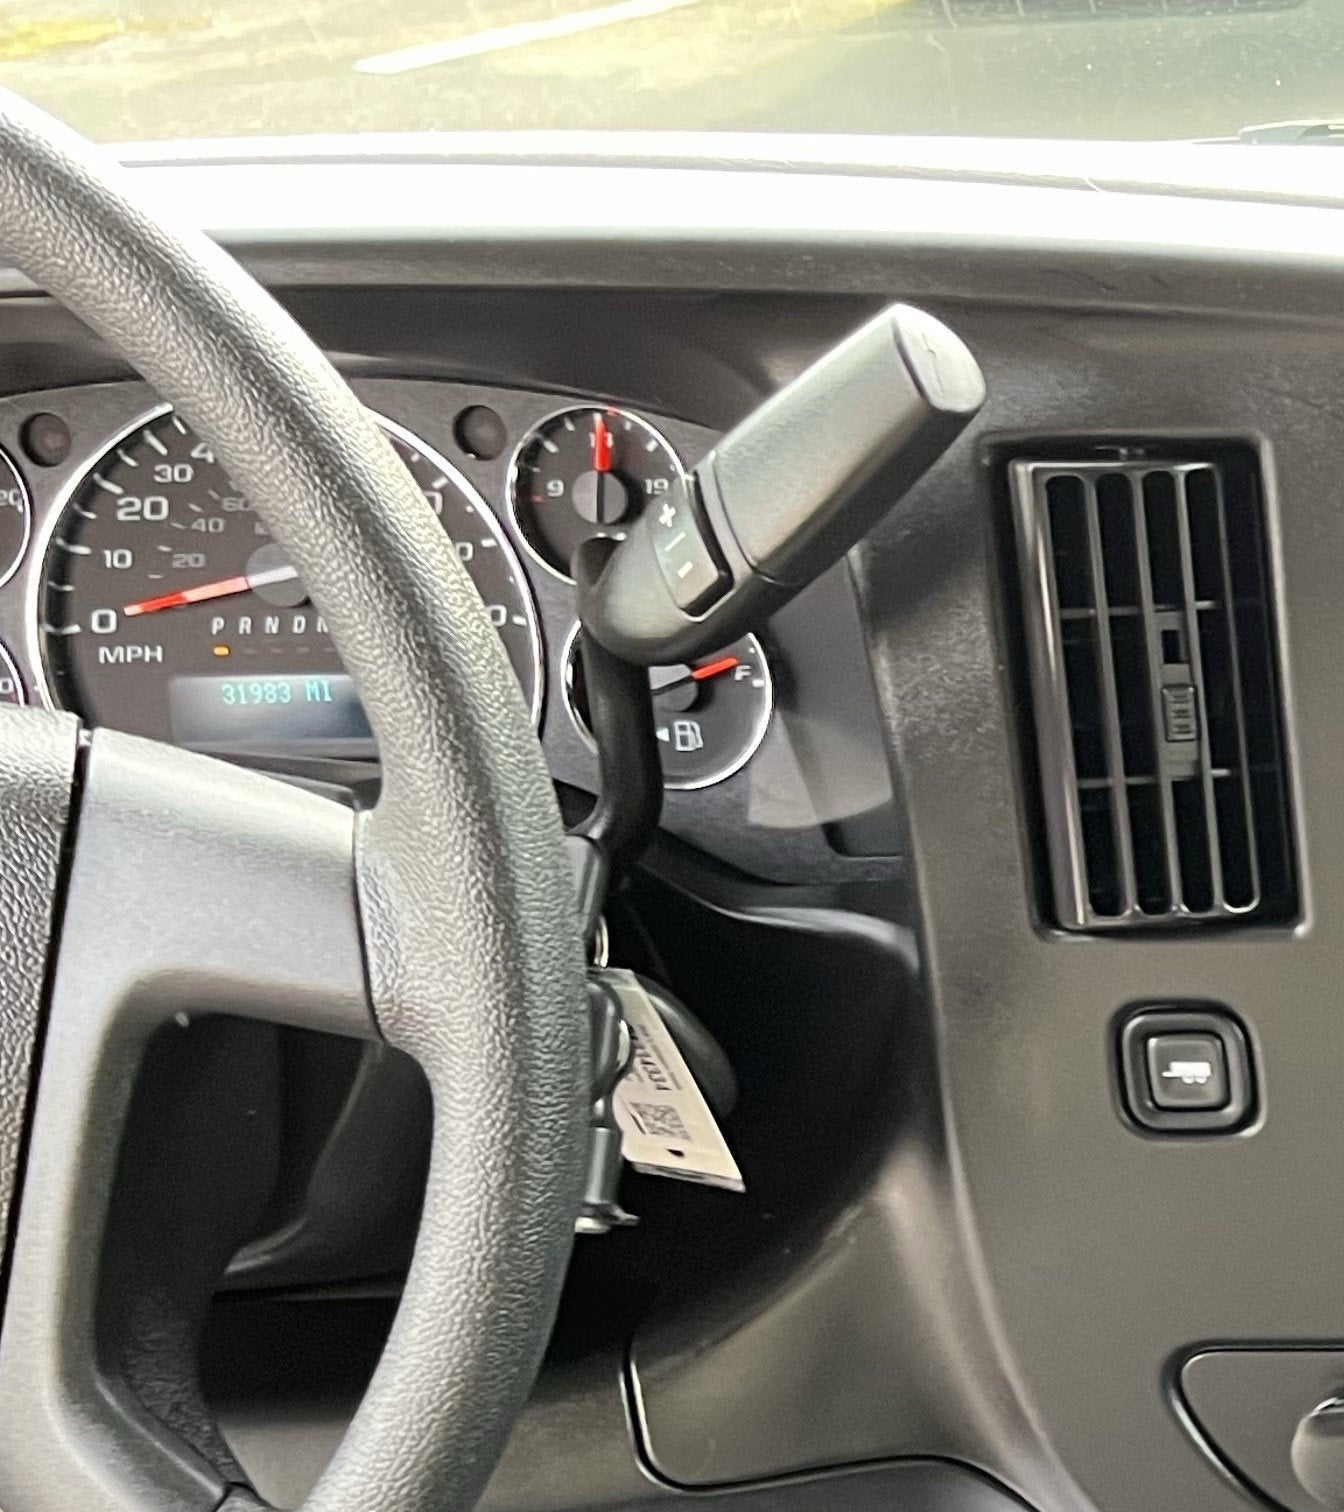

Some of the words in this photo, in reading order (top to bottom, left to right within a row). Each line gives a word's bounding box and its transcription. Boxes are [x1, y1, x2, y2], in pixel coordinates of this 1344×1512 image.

[154, 464, 195, 483] 30
[547, 479, 564, 497] 9
[645, 478, 669, 494] 19
[116, 496, 169, 521] 20
[191, 517, 225, 533] 40
[105, 549, 133, 569] 10
[172, 553, 206, 568] 20
[91, 609, 117, 634] 0
[99, 645, 163, 664] MPH
[733, 665, 752, 681] F
[220, 681, 292, 705] 31983
[304, 678, 333, 702] MI
